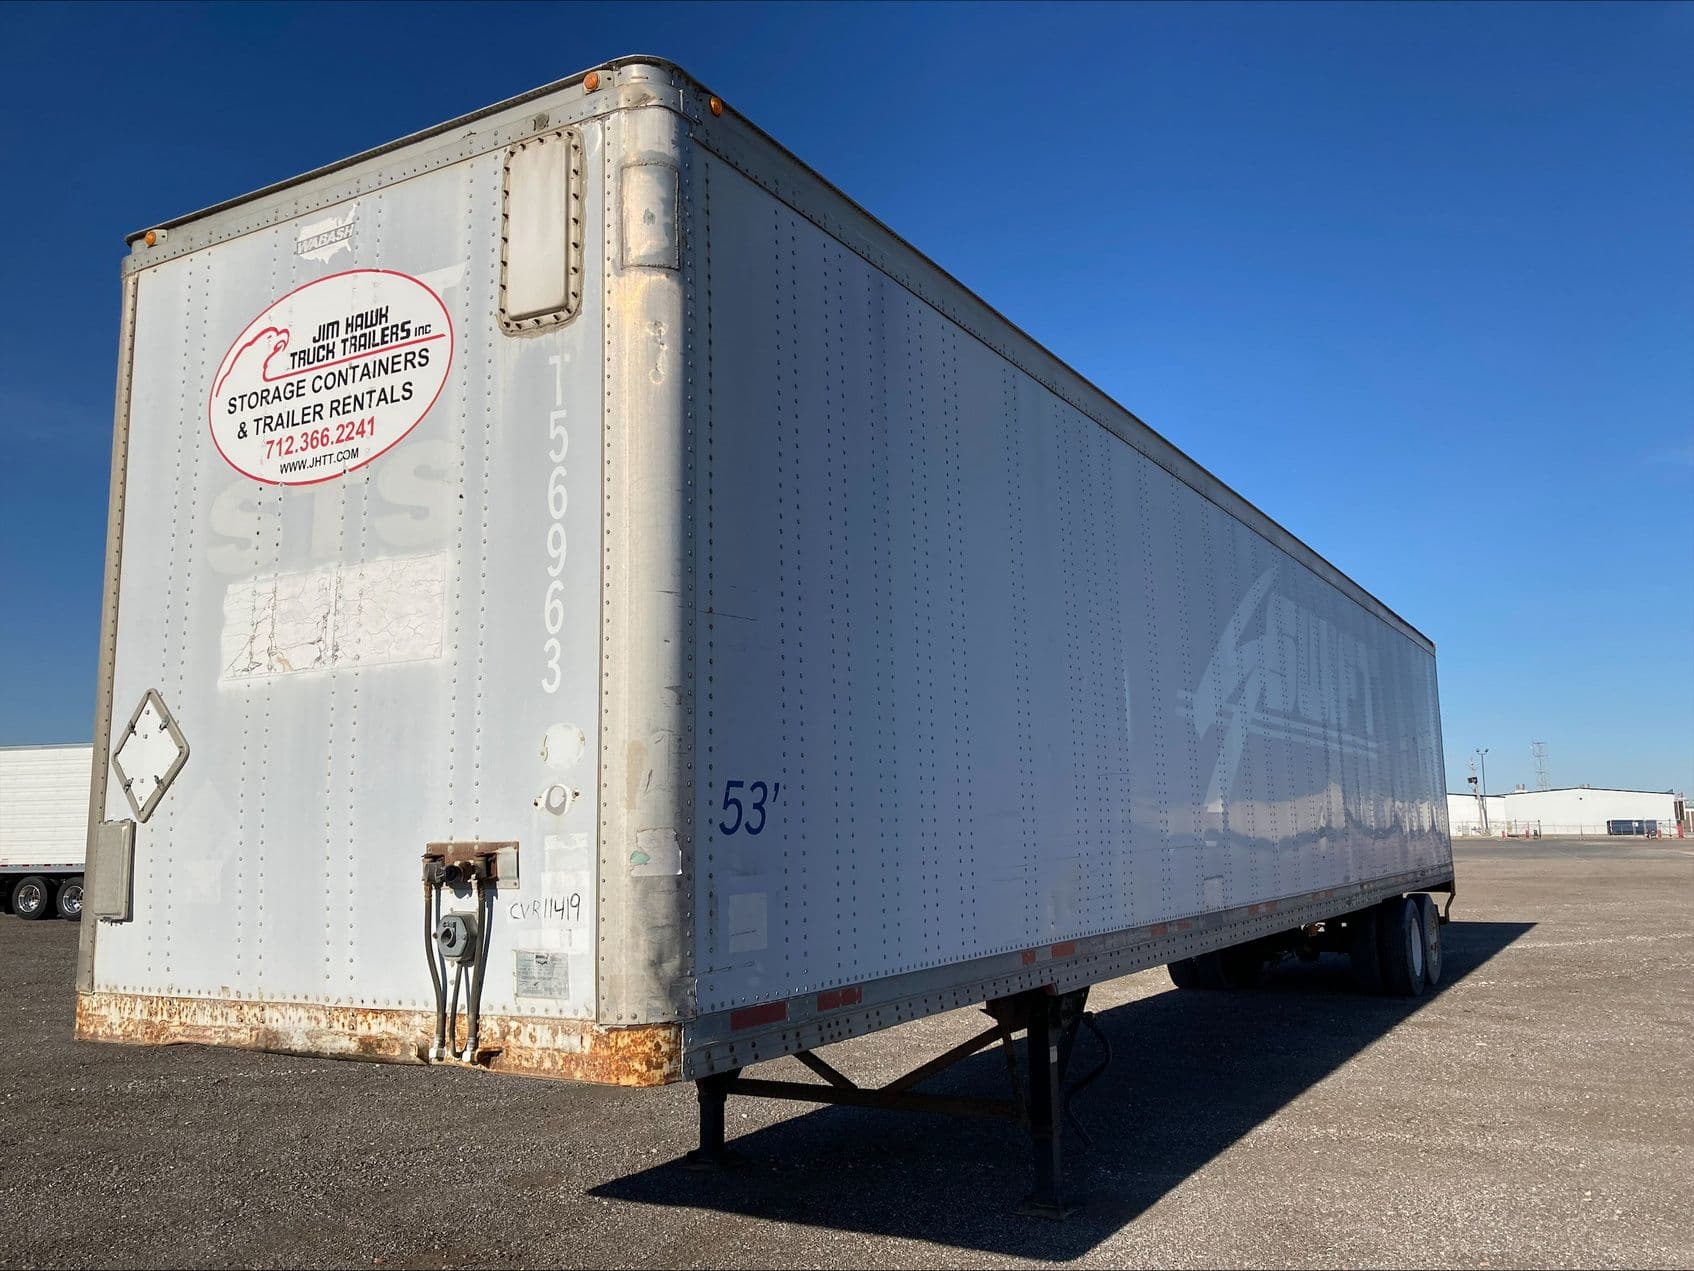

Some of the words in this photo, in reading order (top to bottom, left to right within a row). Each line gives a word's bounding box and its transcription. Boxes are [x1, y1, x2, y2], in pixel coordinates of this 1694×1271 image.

[298, 223, 355, 255] WABASH
[290, 341, 336, 370] TRUCK
[340, 320, 411, 357] TRAILERS
[312, 320, 340, 344] JIM
[345, 305, 389, 334] HAWK
[227, 379, 306, 415] STORAGE
[311, 348, 430, 394] CONTAINERS
[237, 421, 248, 440] &
[253, 403, 324, 437] TRAILER
[329, 381, 413, 419] RENTALS
[265, 416, 375, 460] 712.366.2241
[279, 448, 359, 475] WWW.JHTT.COM
[719, 780, 780, 835] 53'
